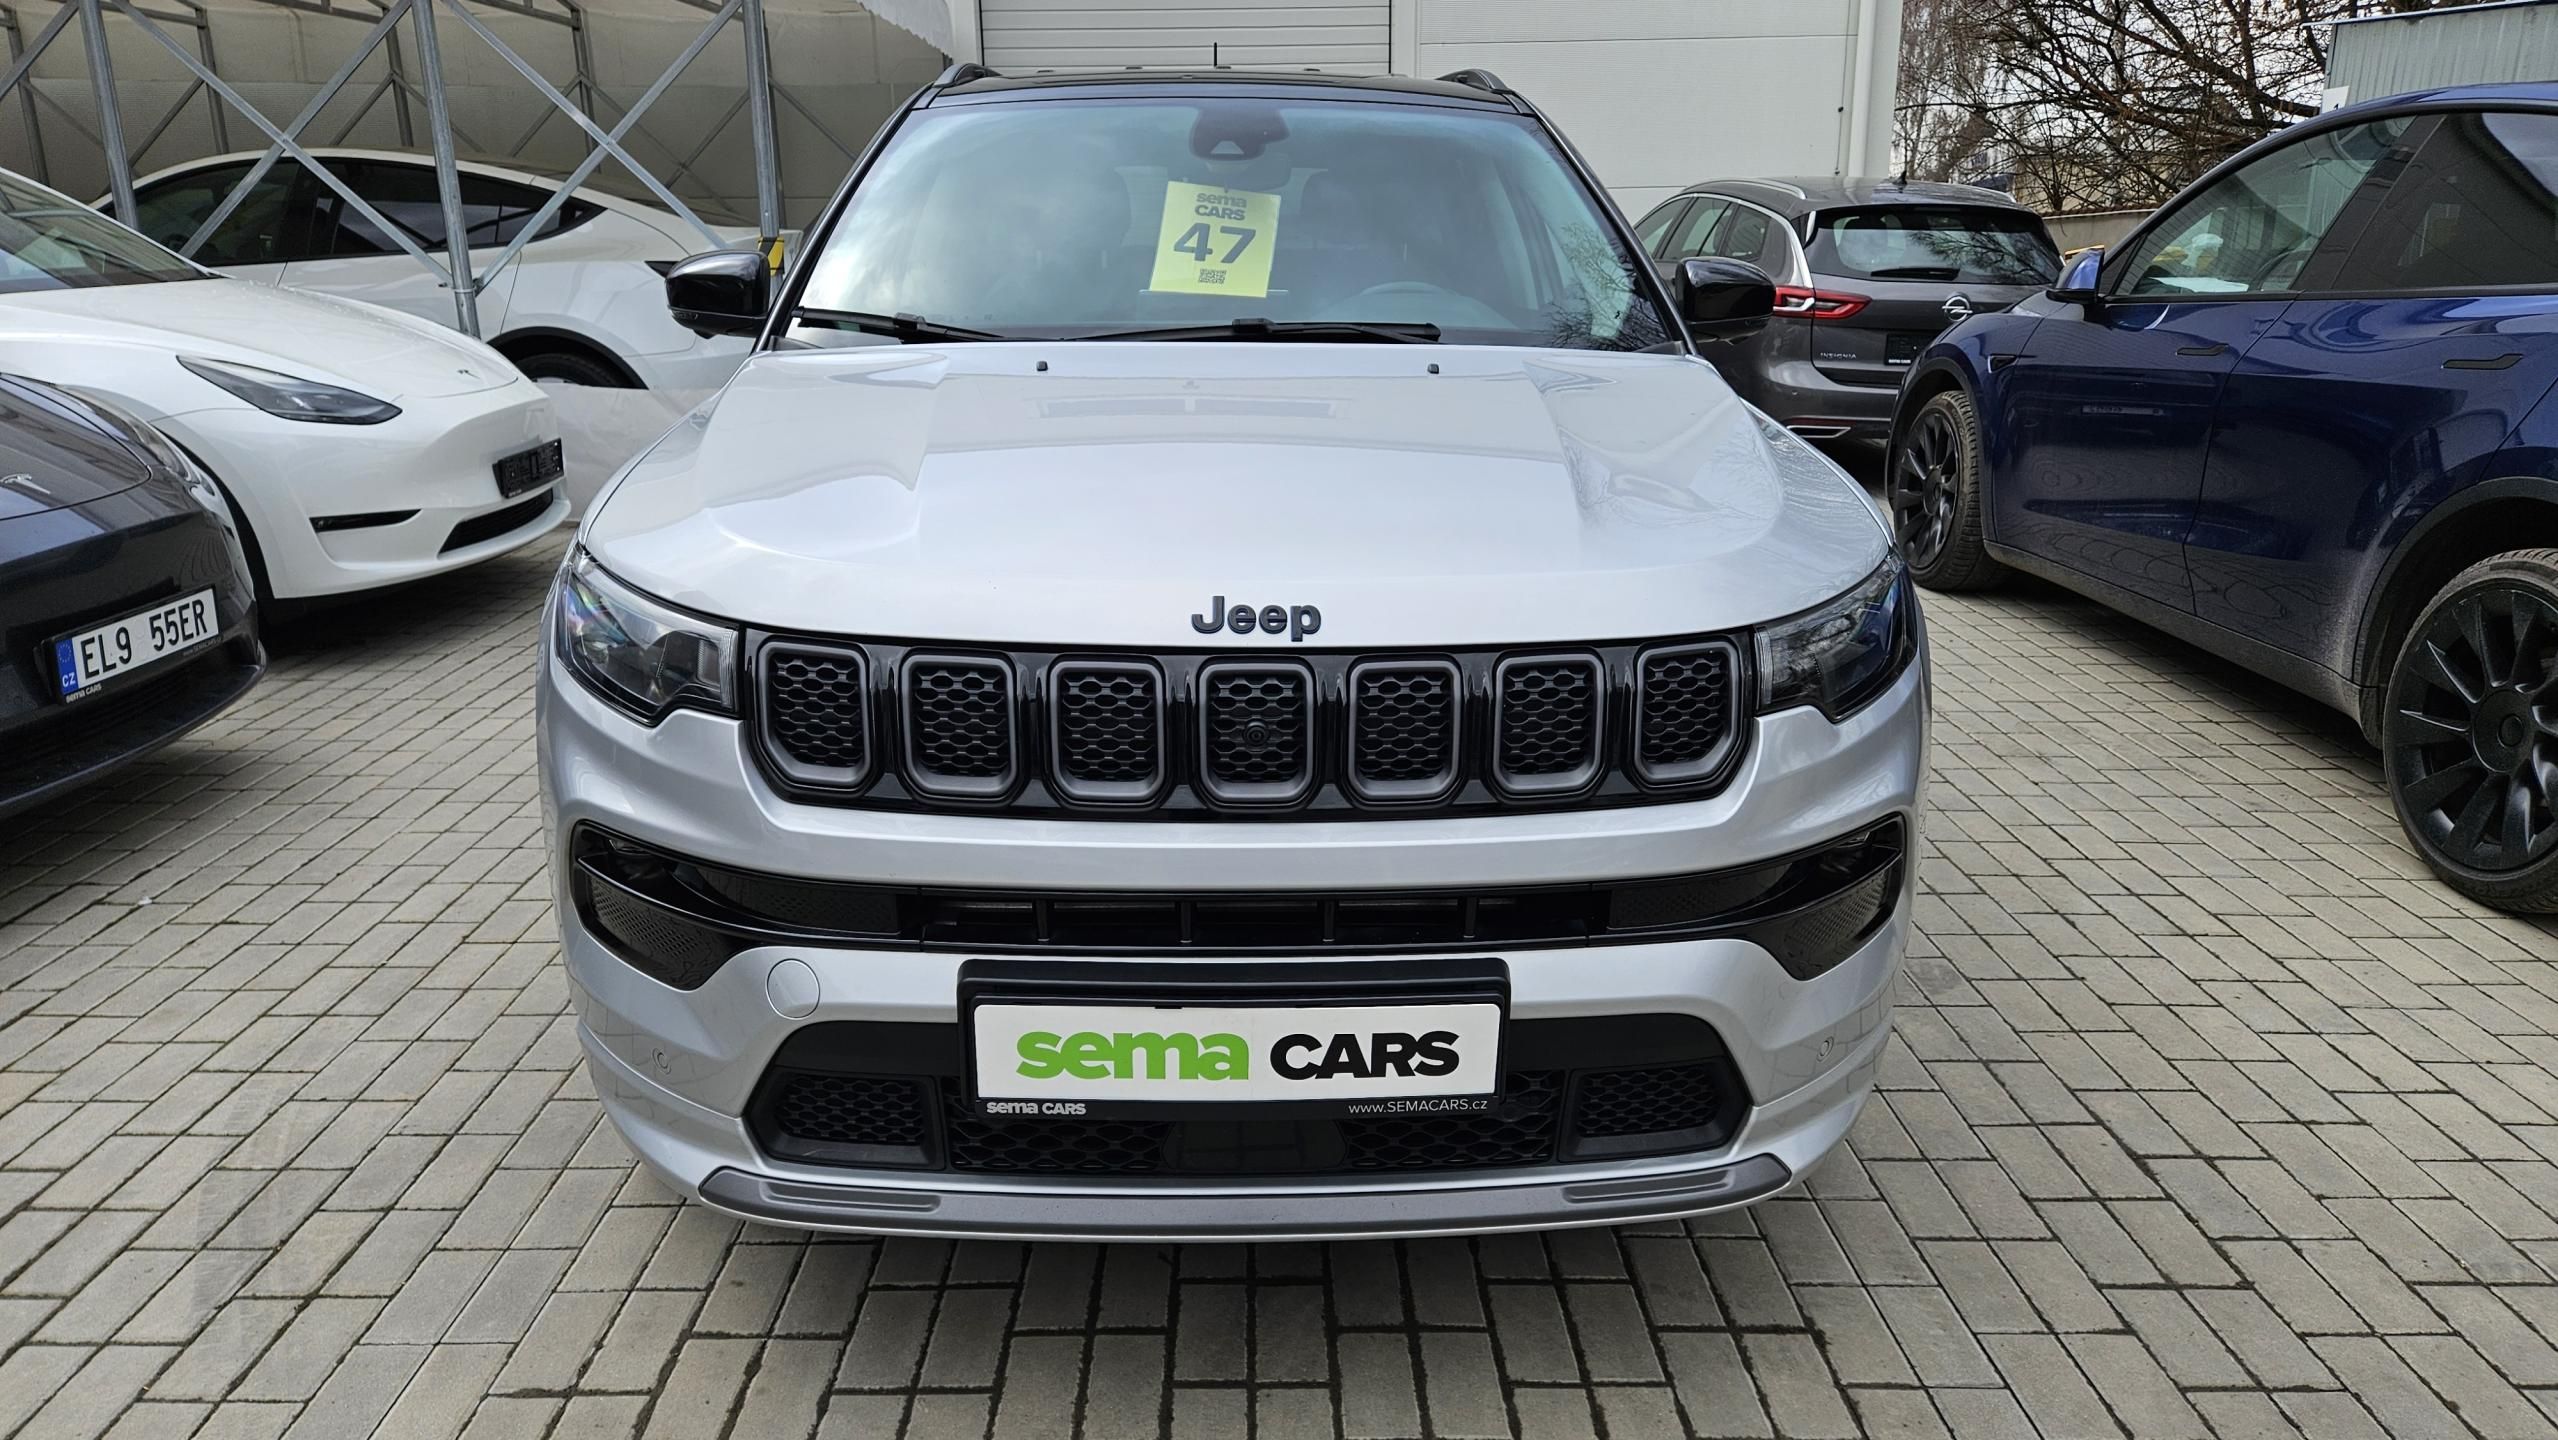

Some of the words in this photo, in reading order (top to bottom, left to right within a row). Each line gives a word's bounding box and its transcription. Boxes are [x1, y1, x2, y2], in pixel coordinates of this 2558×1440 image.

[1196, 192, 1248, 208] sema
[1195, 204, 1245, 221] CARS
[1173, 222, 1257, 264] 47
[1191, 595, 1322, 642] Jeep
[80, 626, 133, 680] EL9
[149, 599, 208, 652] 55ER
[62, 671, 77, 688] CZ
[1015, 1030, 1250, 1081] sema
[1269, 1030, 1461, 1081] CARS
[986, 1101, 1039, 1114] sema
[1041, 1102, 1087, 1115] CARS
[1348, 1098, 1488, 1114] www.SEMACARS.cz
